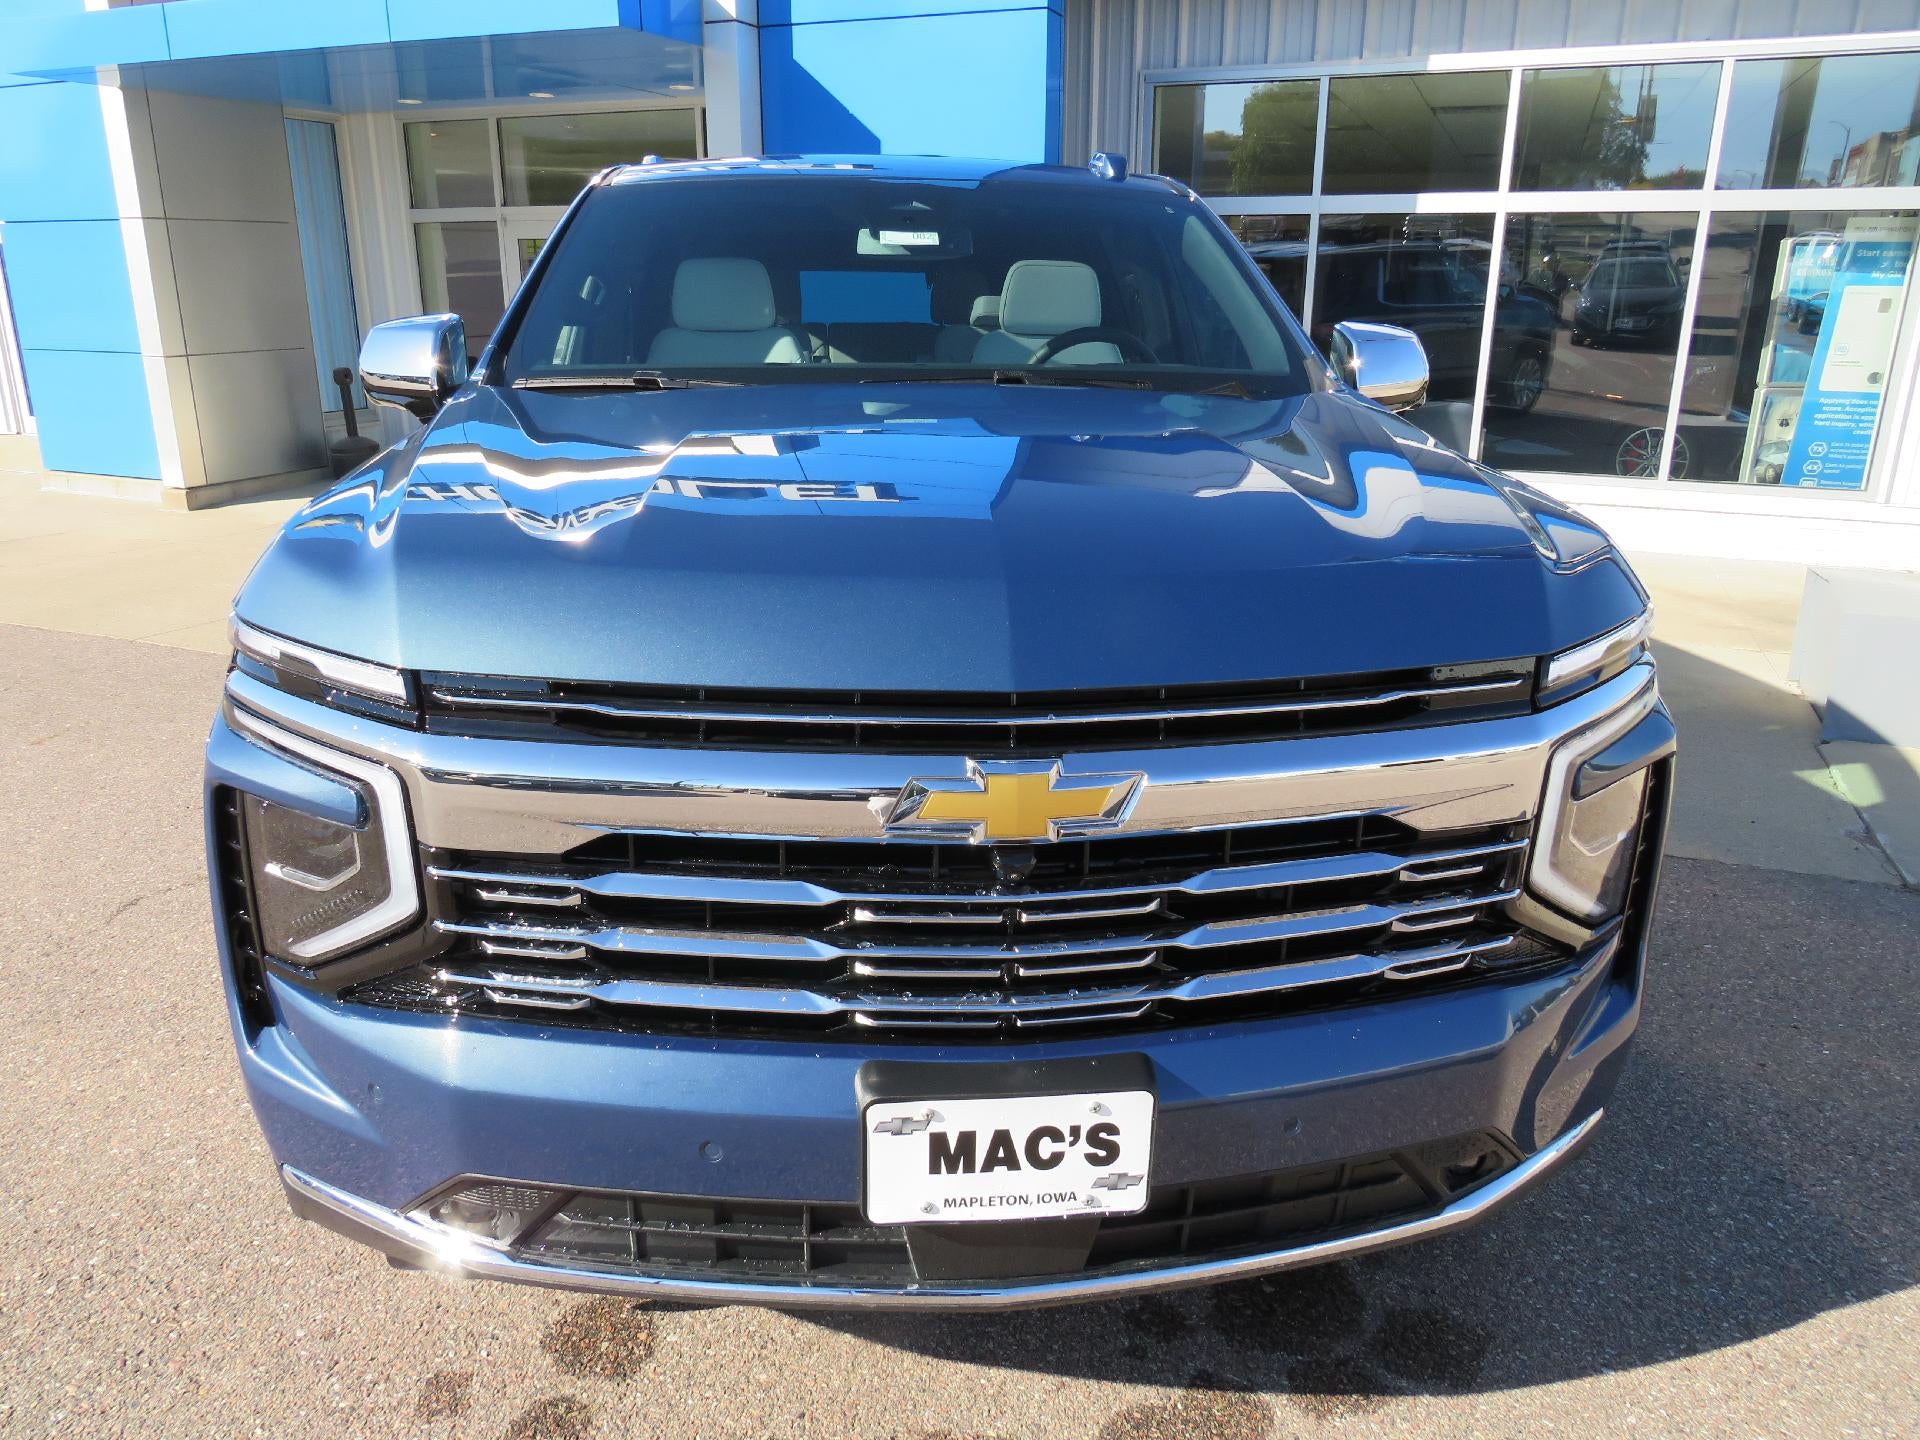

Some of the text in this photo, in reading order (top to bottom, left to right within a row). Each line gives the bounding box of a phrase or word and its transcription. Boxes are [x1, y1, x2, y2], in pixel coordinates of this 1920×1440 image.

[928, 1121, 1121, 1175] MAC'S
[943, 1192, 1078, 1209] MAPLETON, IOWA
